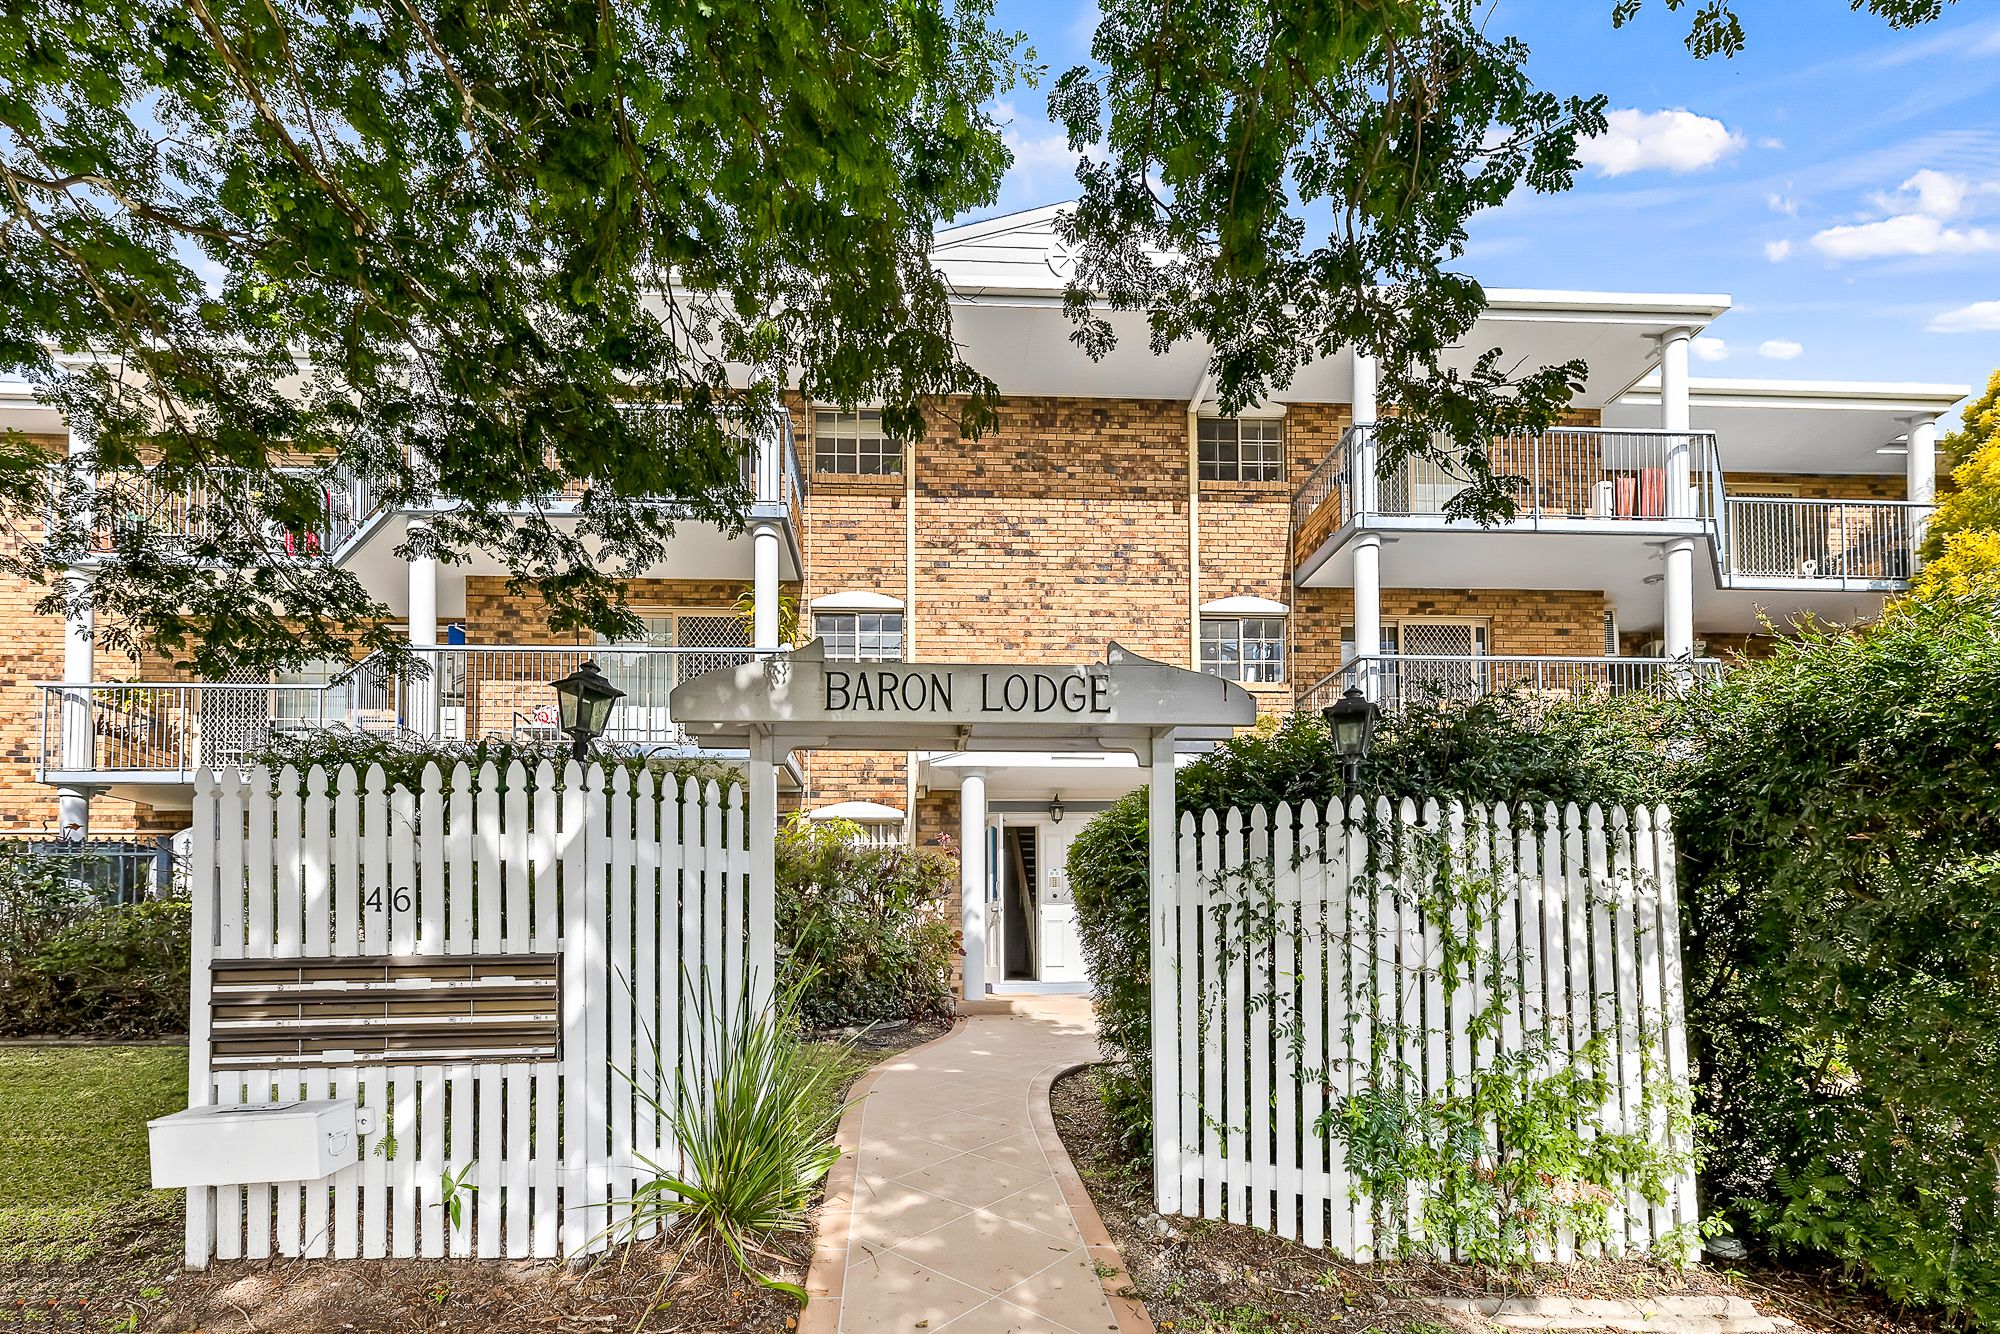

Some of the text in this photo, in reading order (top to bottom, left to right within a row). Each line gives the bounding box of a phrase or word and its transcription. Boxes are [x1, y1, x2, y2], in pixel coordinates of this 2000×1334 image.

[824, 671, 1111, 713] BARON LODGE
[365, 886, 412, 913] 46
